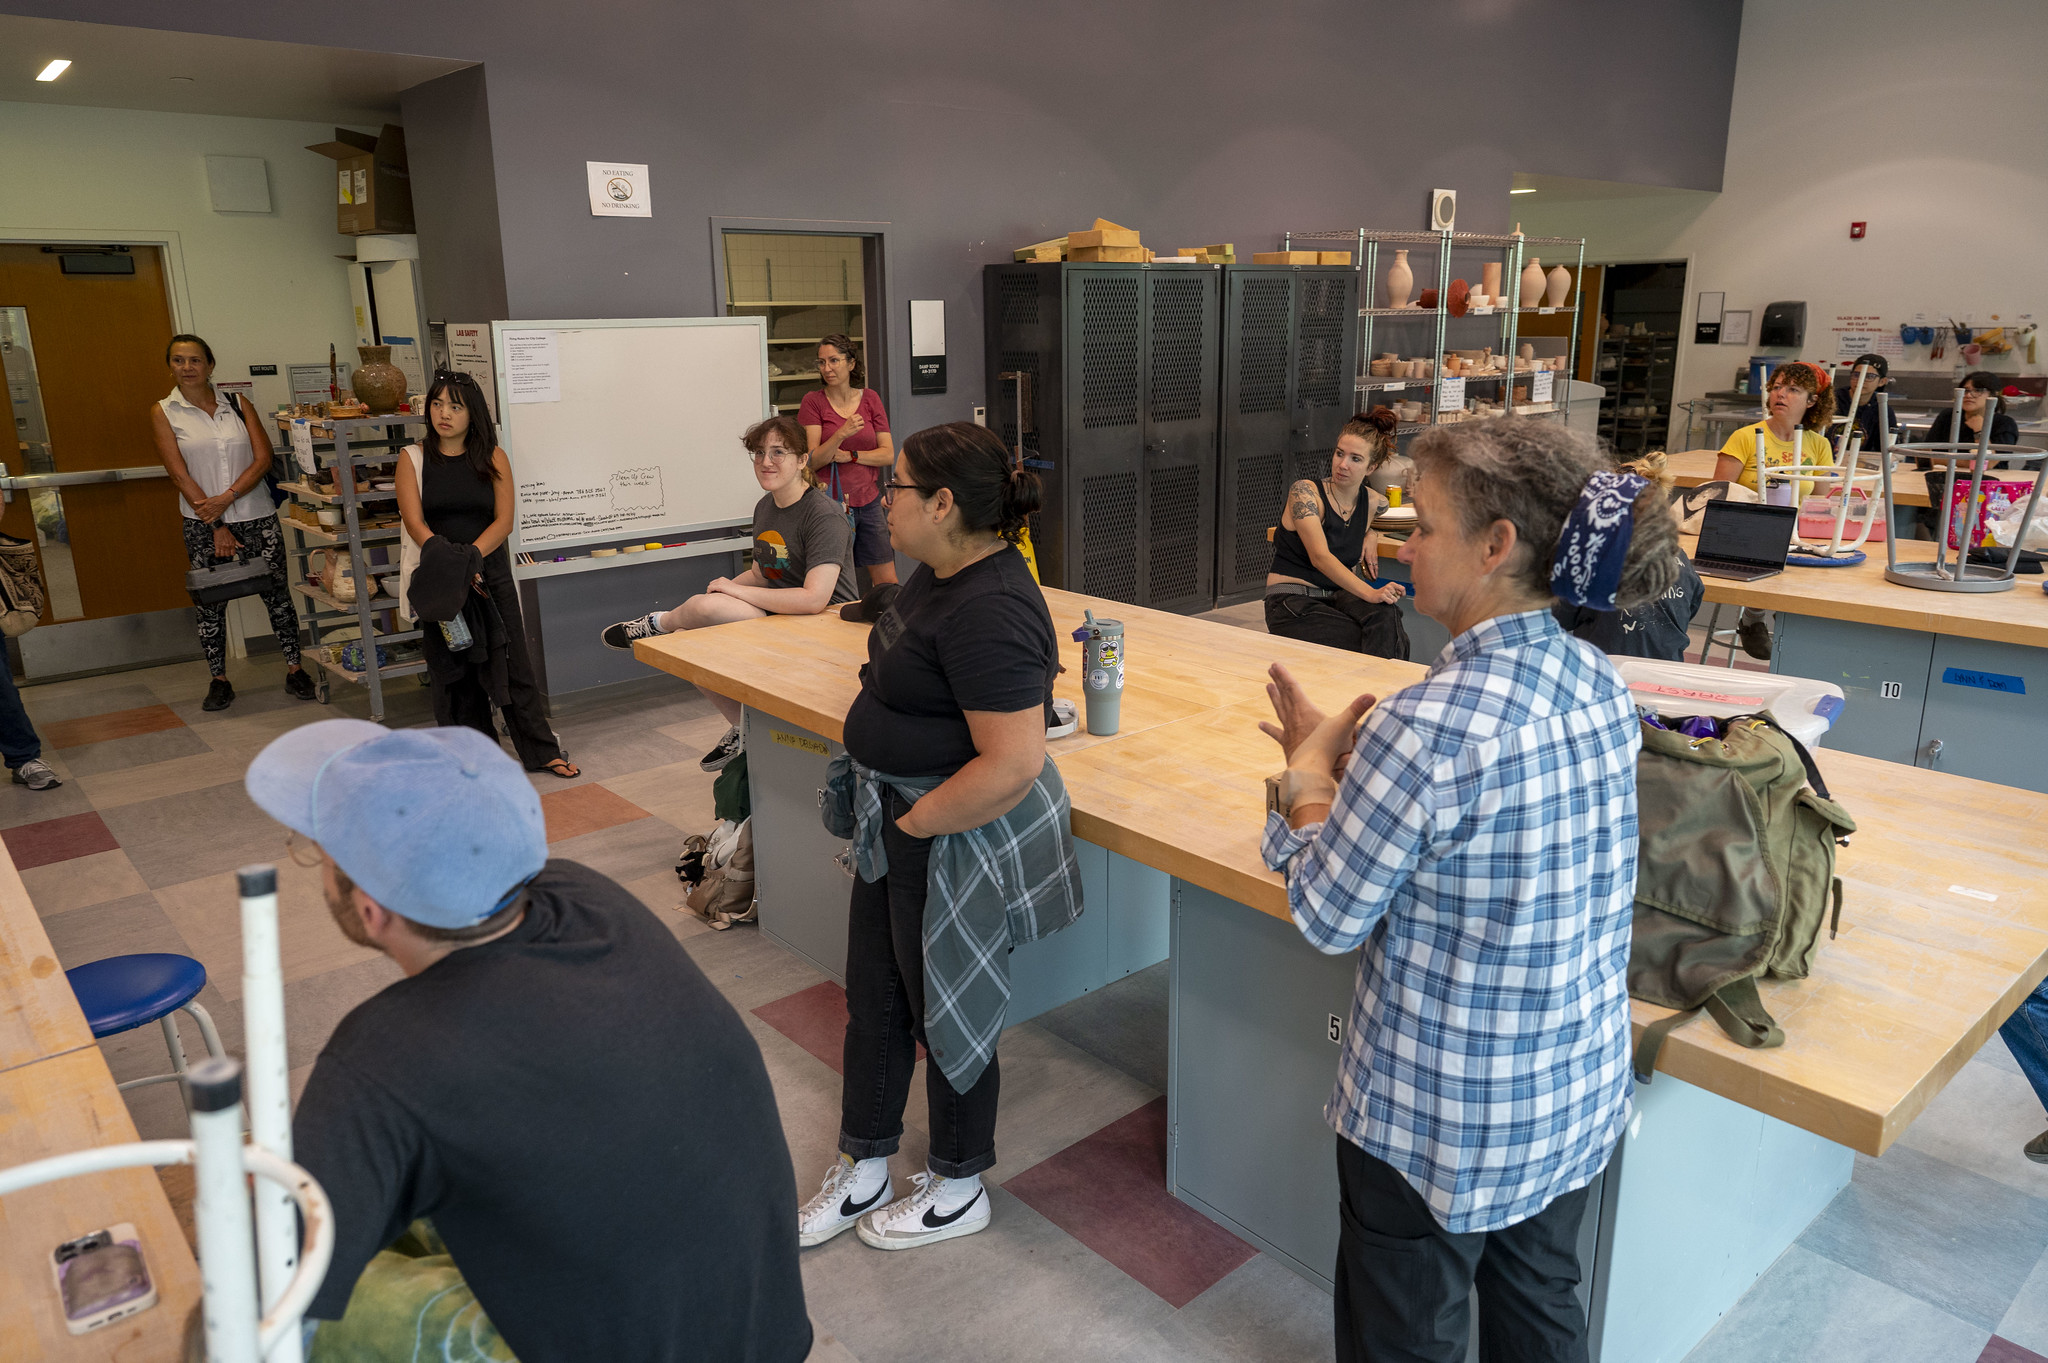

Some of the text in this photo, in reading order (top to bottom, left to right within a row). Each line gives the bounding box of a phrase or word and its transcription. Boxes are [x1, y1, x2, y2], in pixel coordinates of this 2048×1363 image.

[456, 329, 478, 337] LAB SAFETY
[1884, 682, 1900, 698] 10
[1330, 1015, 1340, 1041] 5
